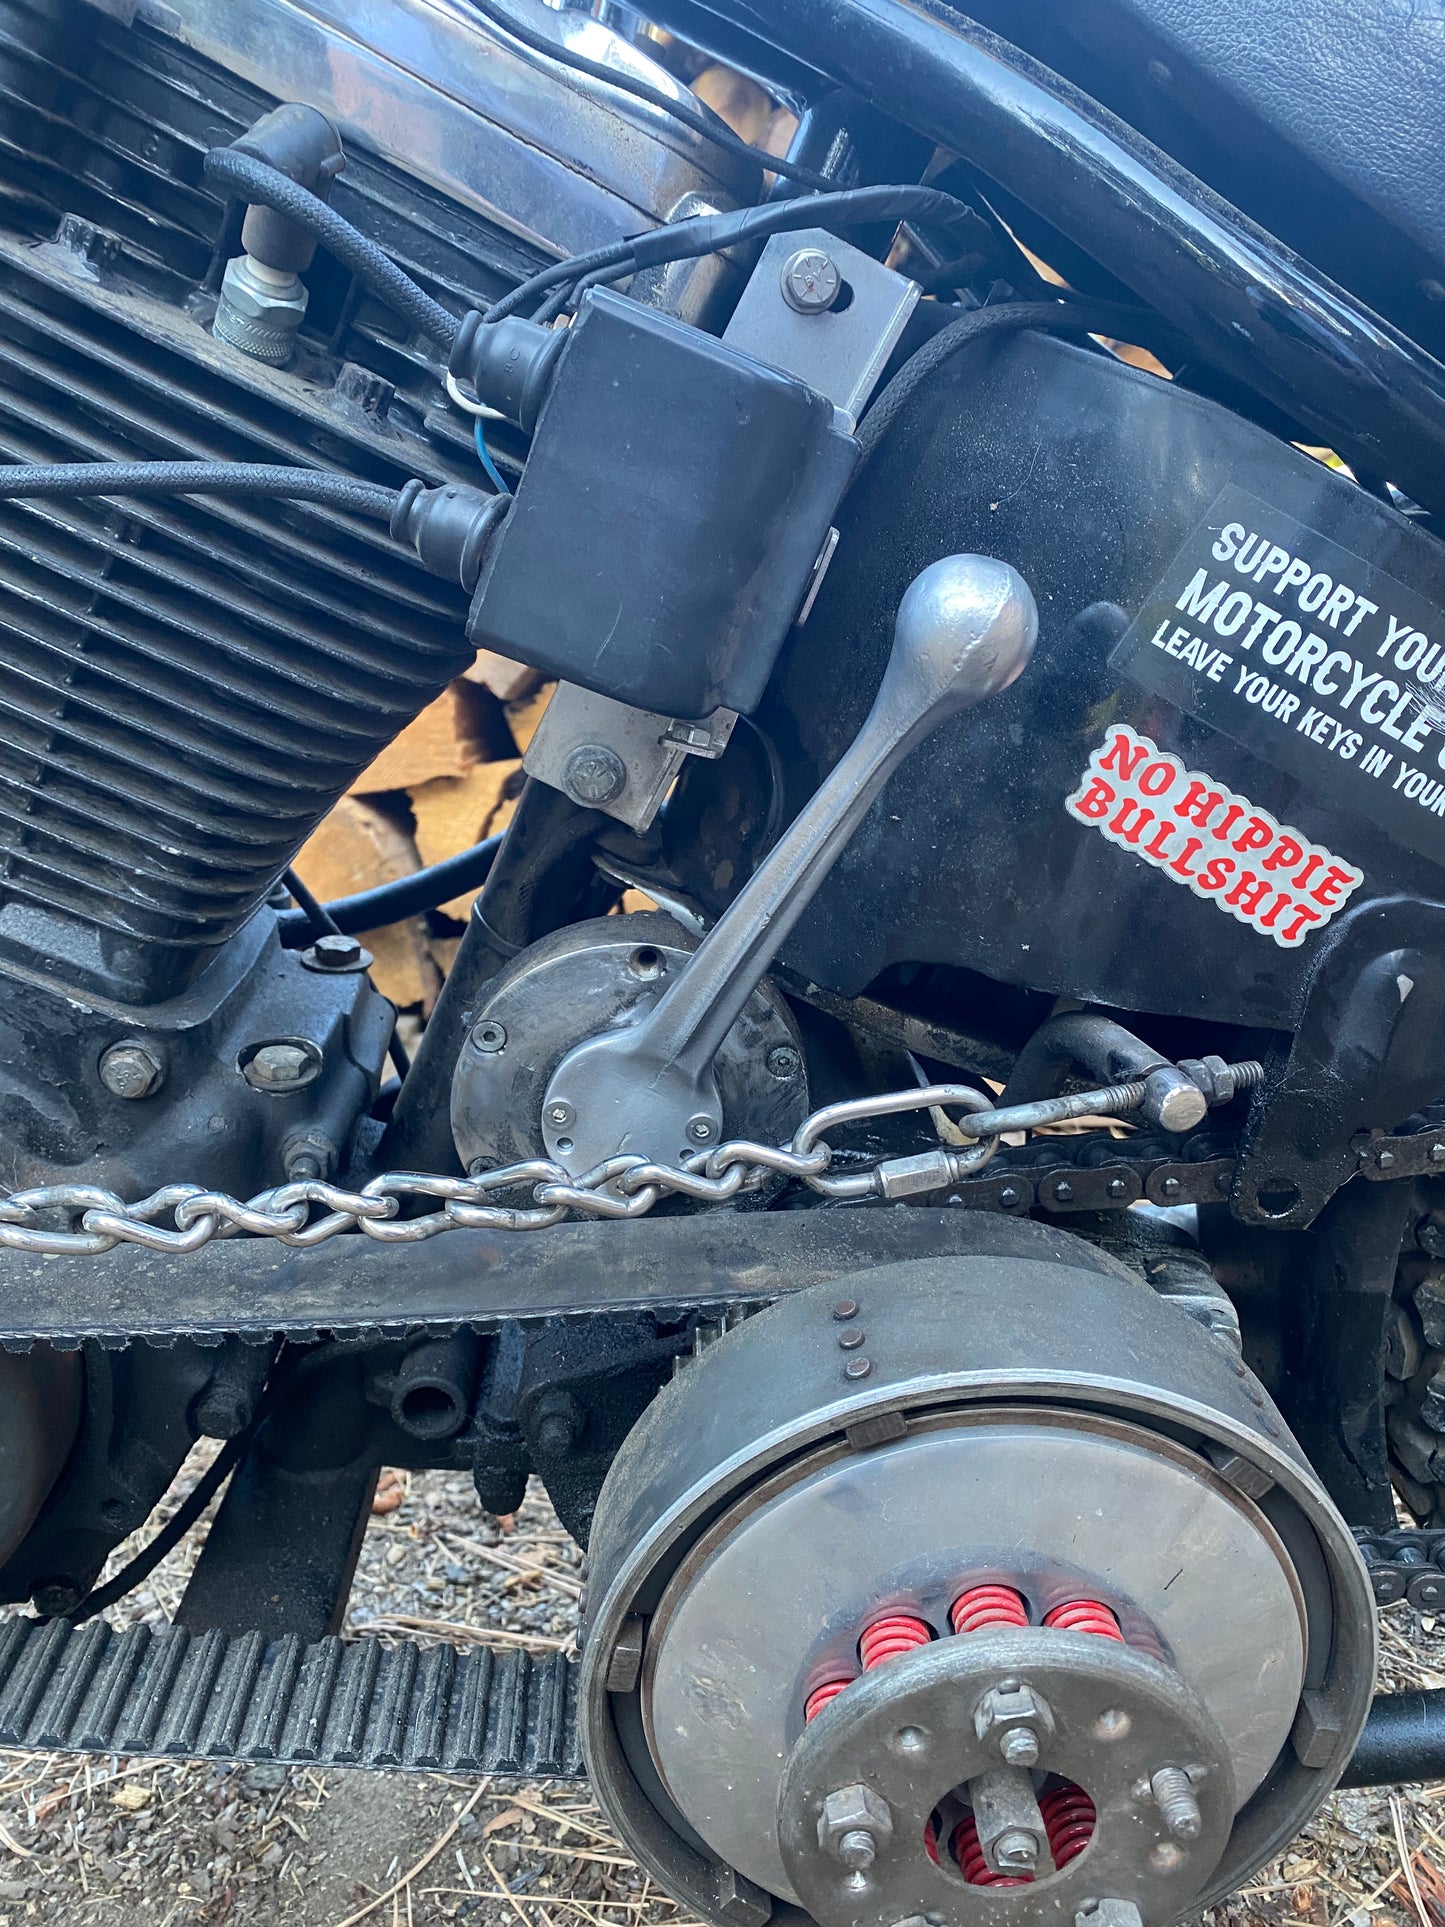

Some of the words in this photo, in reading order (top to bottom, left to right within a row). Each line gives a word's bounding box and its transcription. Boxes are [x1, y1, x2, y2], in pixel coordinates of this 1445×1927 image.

[1175, 567, 1443, 753] MOTORCYCLE
[1211, 522, 1379, 637] SUPPORT
[1150, 619, 1234, 683] LEAVE
[1232, 664, 1301, 724] YOUR
[1296, 706, 1363, 760] KEYS
[1358, 744, 1394, 779] IN
[1074, 777, 1322, 941] BULLSHIT
[1098, 734, 1176, 797] NO
[1173, 781, 1355, 906] HIPPIE
